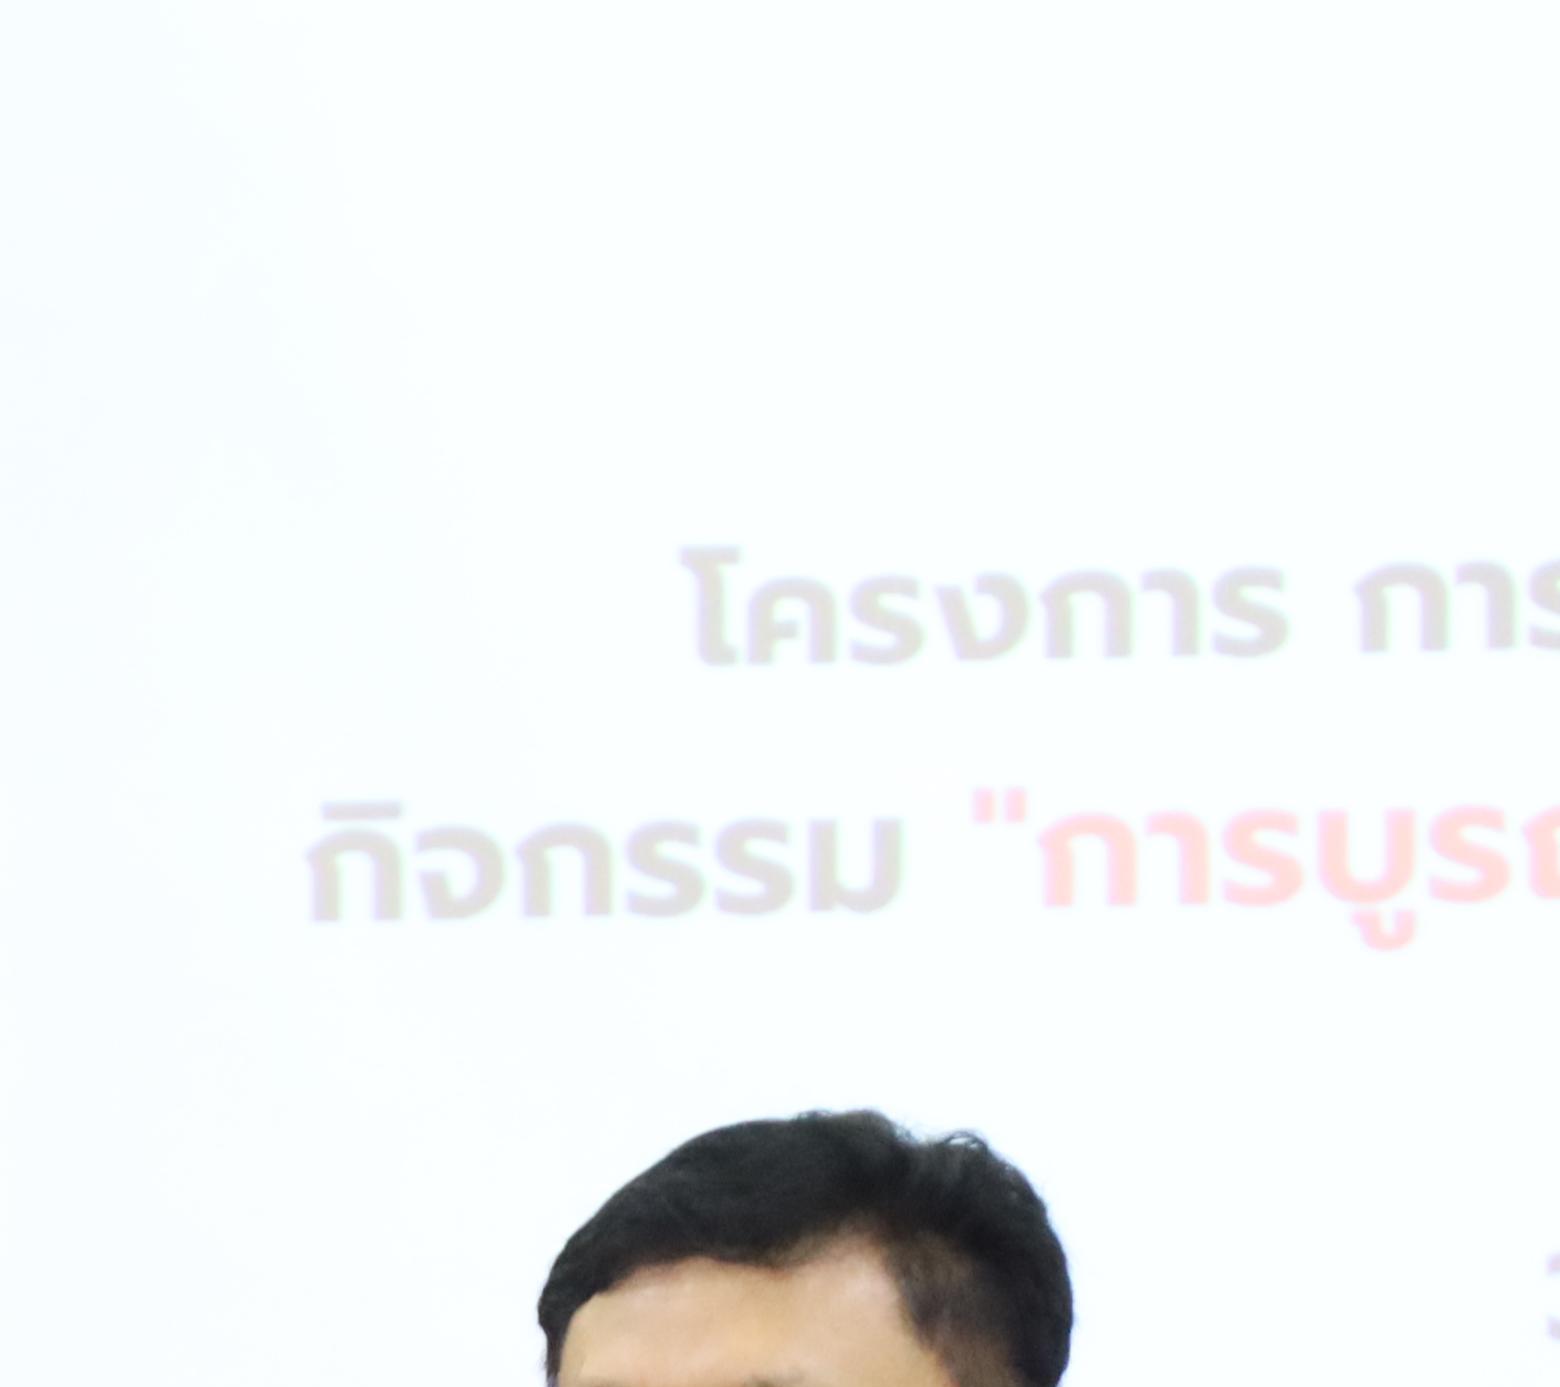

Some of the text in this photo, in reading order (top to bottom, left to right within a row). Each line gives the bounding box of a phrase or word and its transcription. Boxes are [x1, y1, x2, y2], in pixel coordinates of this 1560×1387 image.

[681, 545, 1290, 666] โครงการ
[307, 801, 905, 921] กิจกรรม
